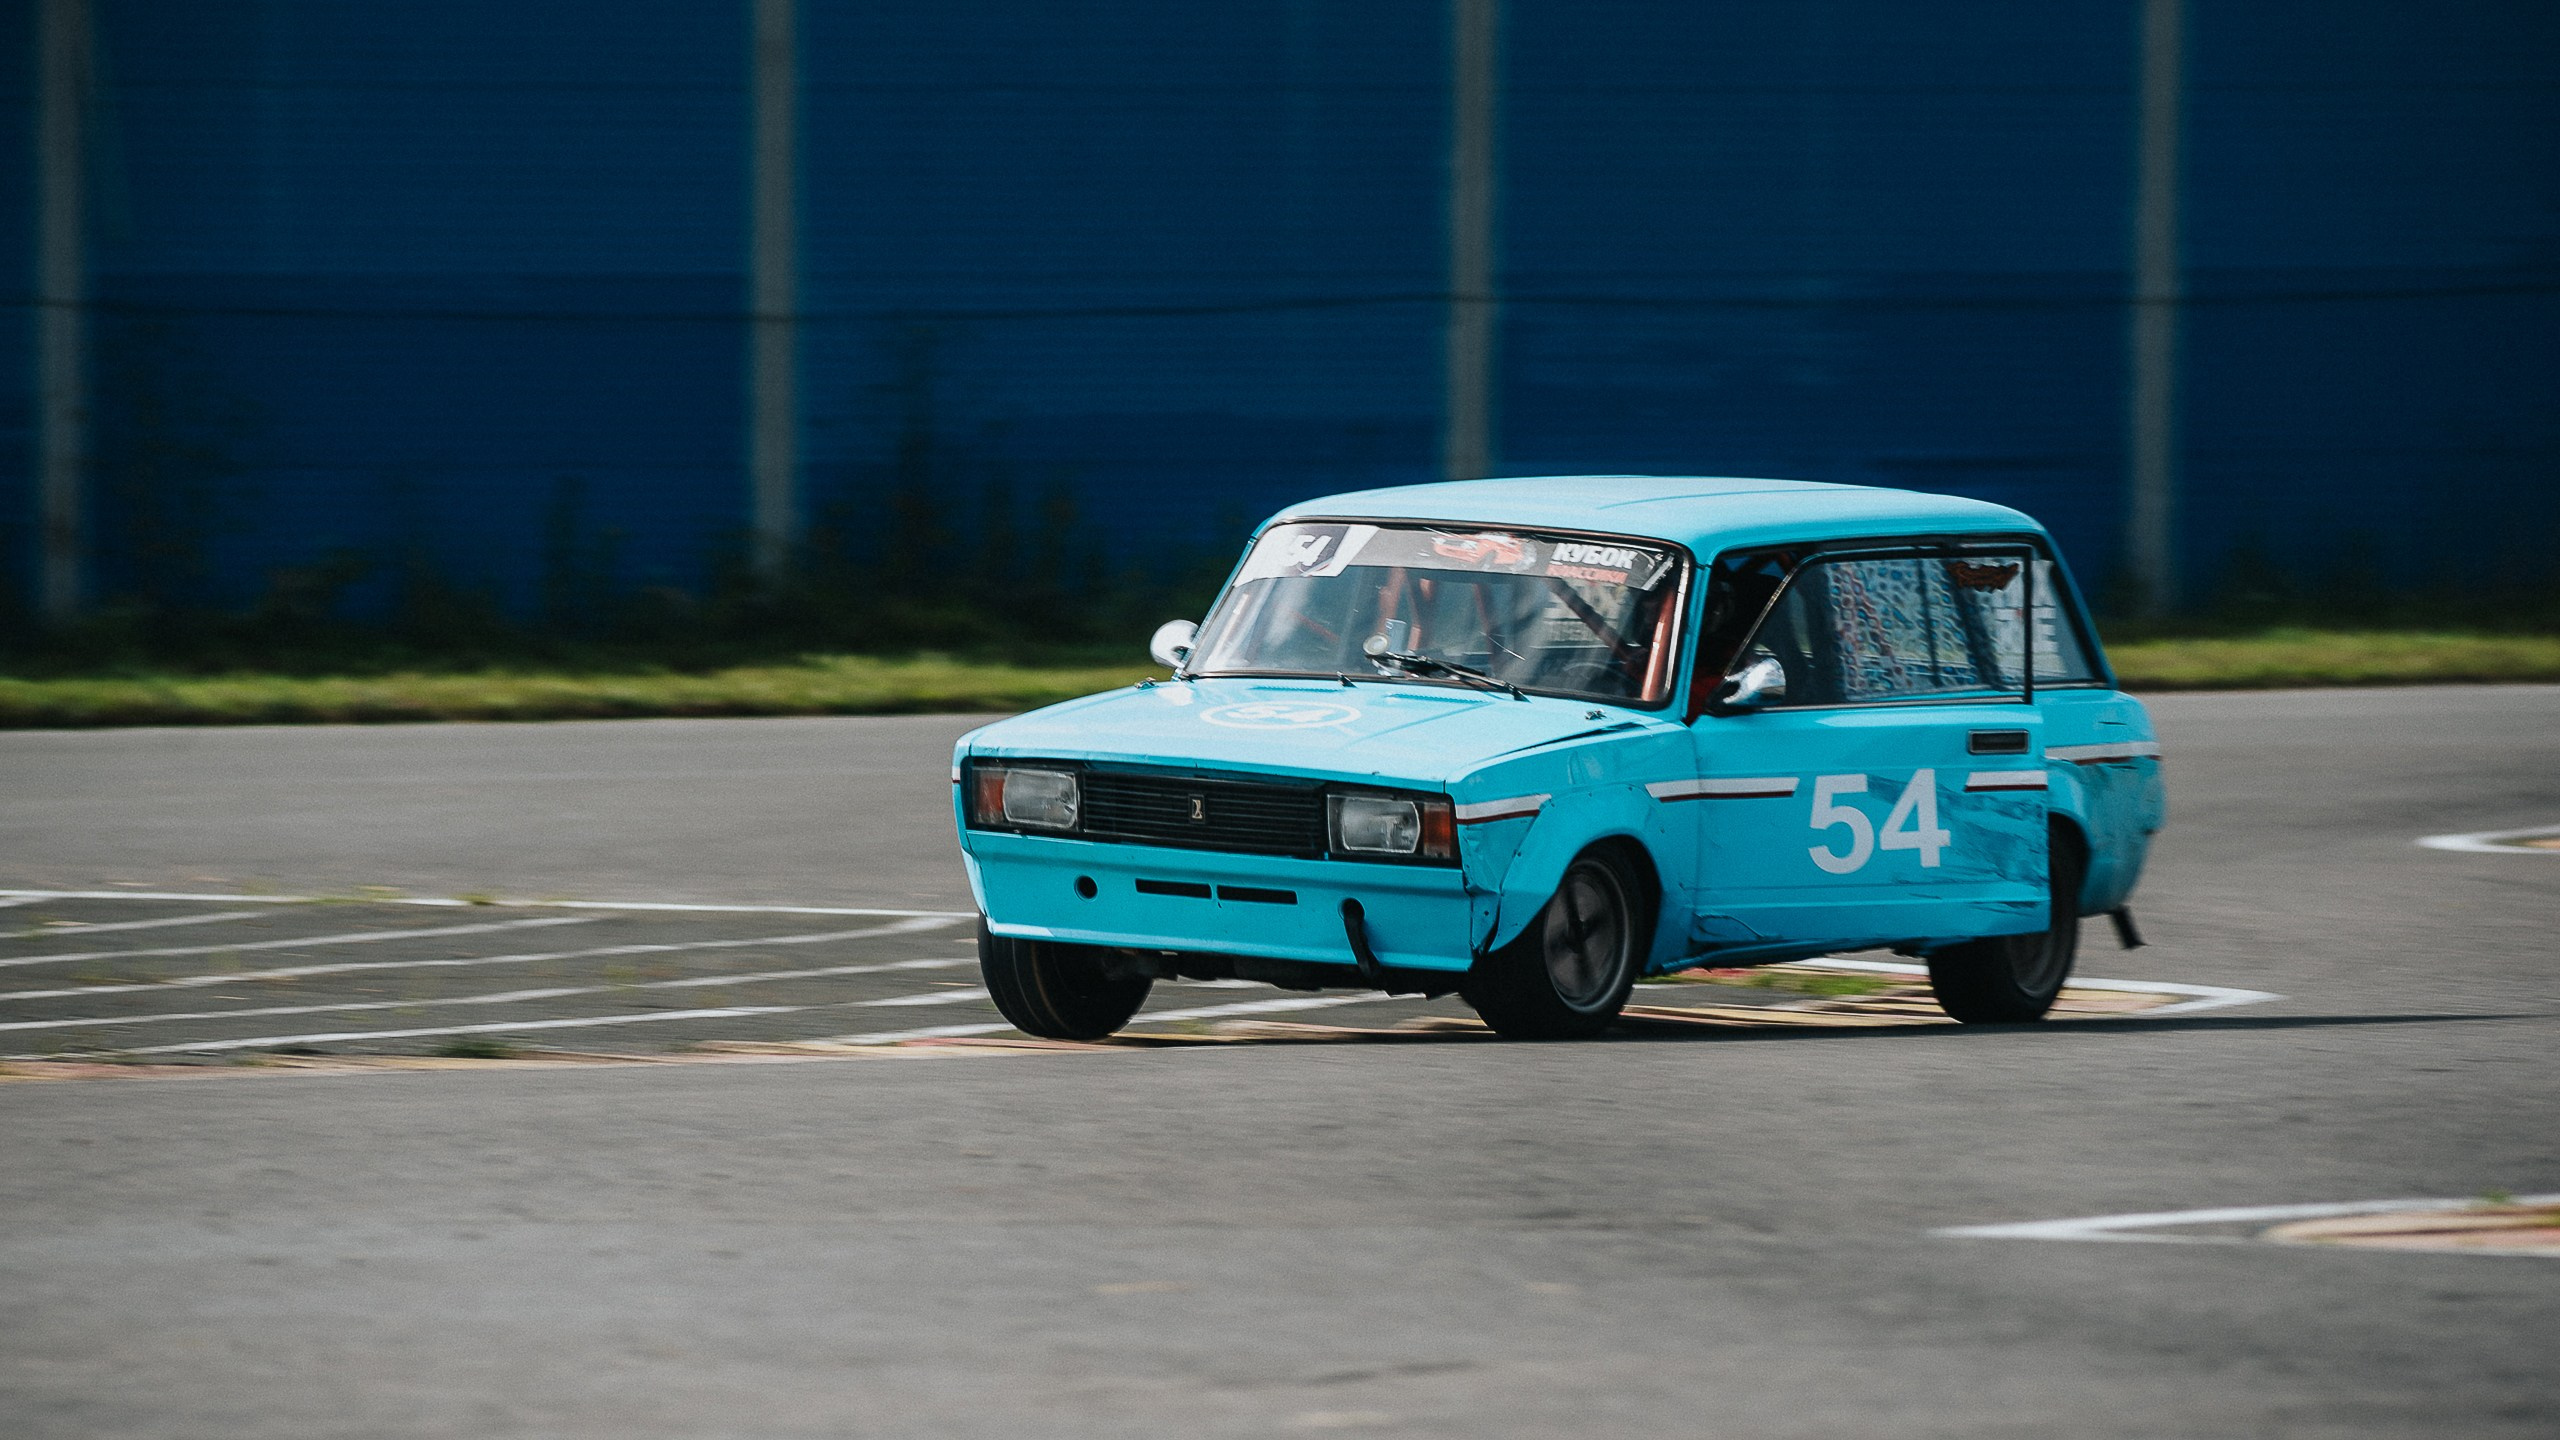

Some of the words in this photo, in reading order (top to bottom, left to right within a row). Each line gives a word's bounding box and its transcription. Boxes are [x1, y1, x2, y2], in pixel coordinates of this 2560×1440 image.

[1551, 542, 1638, 570] КУБОК
[1225, 705, 1335, 723] 54
[1808, 768, 1951, 875] 54
